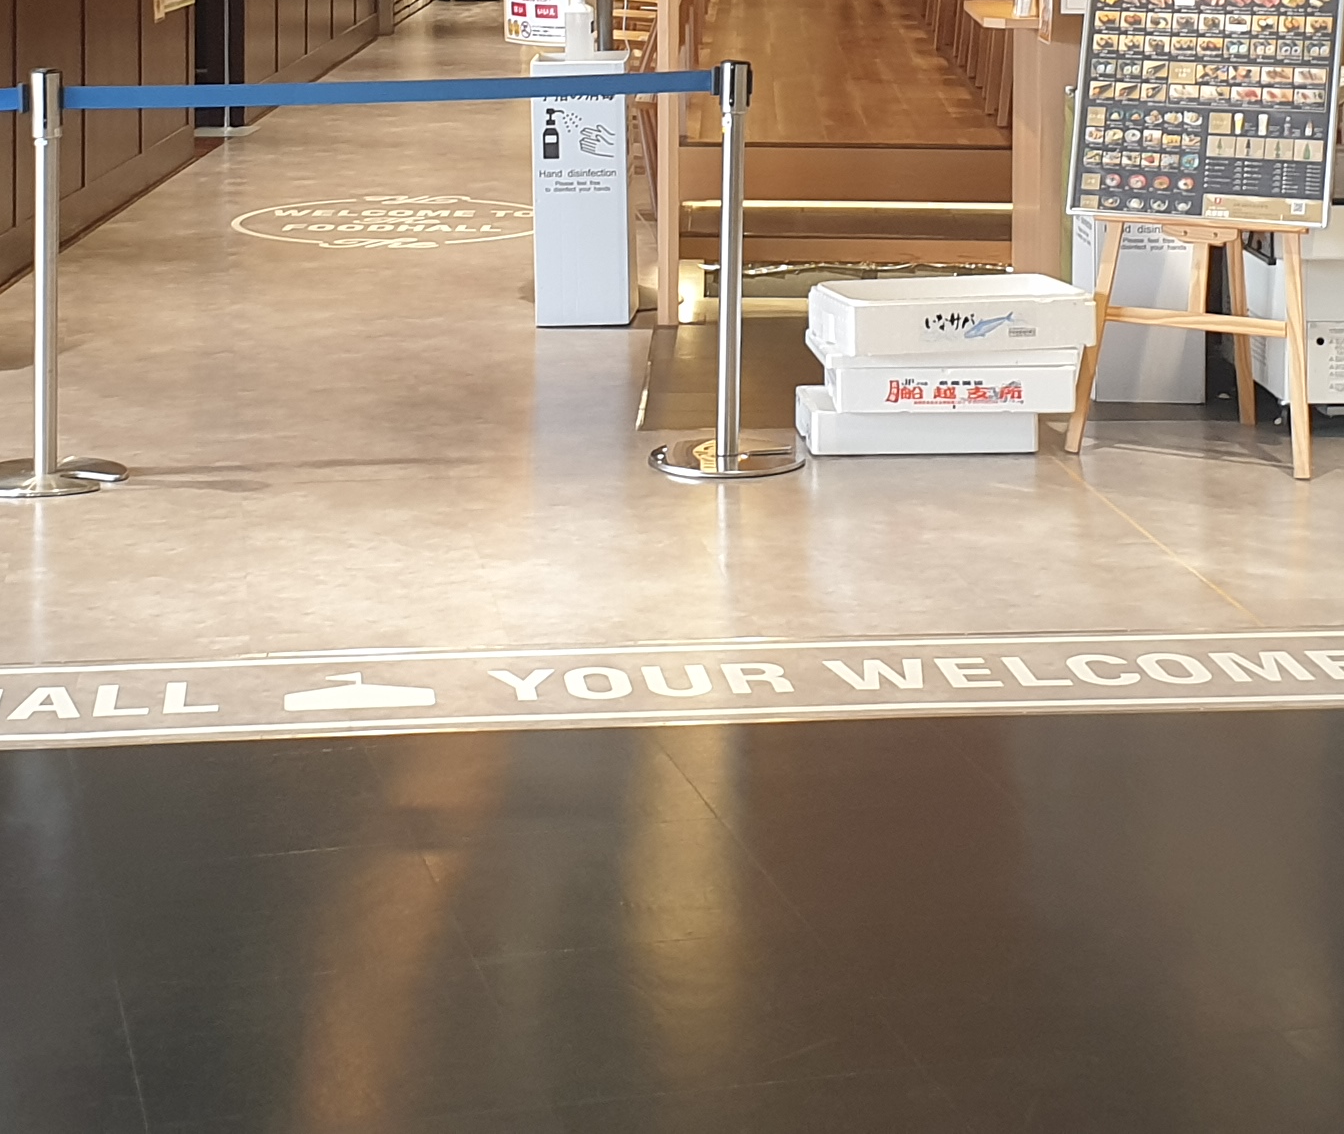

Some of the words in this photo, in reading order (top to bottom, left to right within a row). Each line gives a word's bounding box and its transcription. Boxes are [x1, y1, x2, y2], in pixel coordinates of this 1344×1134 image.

[538, 169, 563, 178] Hand
[567, 168, 617, 178] disinfection
[273, 209, 477, 217] WELCOME
[489, 209, 534, 217] TO
[281, 224, 502, 232] FOODHALL
[487, 663, 796, 702] YOUR
